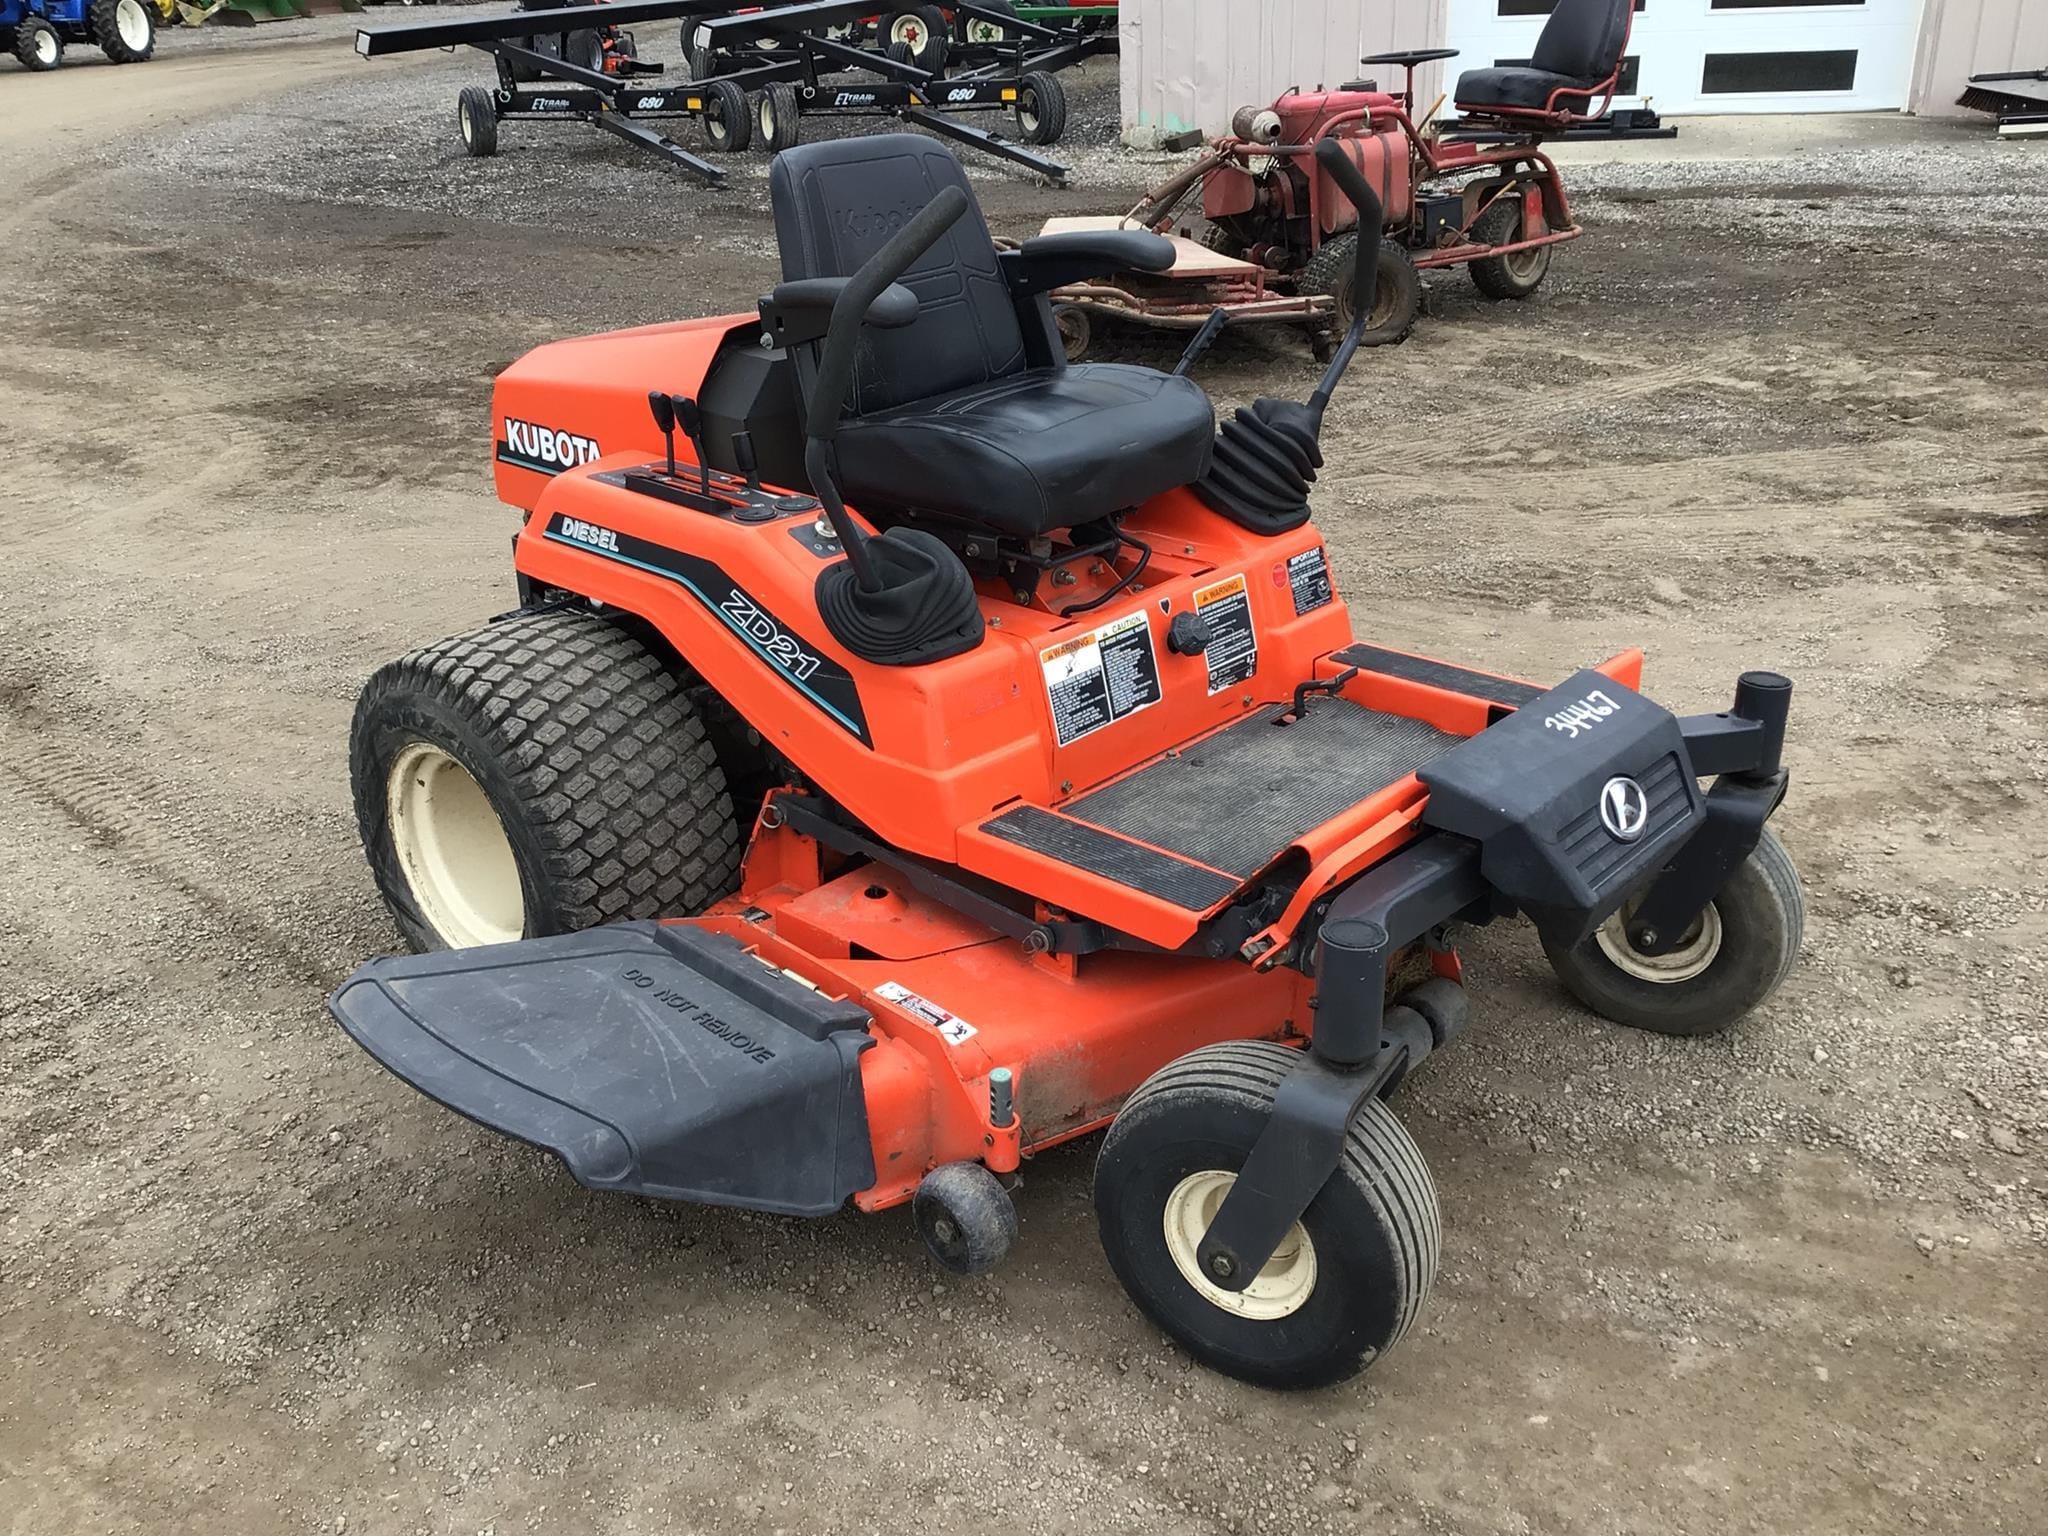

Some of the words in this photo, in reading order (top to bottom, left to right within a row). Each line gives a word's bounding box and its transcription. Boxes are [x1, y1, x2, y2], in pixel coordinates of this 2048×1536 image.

[637, 97, 665, 109] 680
[947, 88, 977, 101] 680
[504, 417, 602, 467] KUBOTA
[561, 516, 620, 553] DIESEL
[1210, 581, 1239, 599] WARNING
[720, 588, 821, 681] ZD21
[1112, 615, 1141, 634] CAUTION
[1053, 636, 1090, 658] WARNING
[1545, 690, 1622, 738] 34467
[622, 968, 655, 989] DO
[653, 988, 699, 1013] NOT
[691, 1012, 777, 1065] REMOVE
